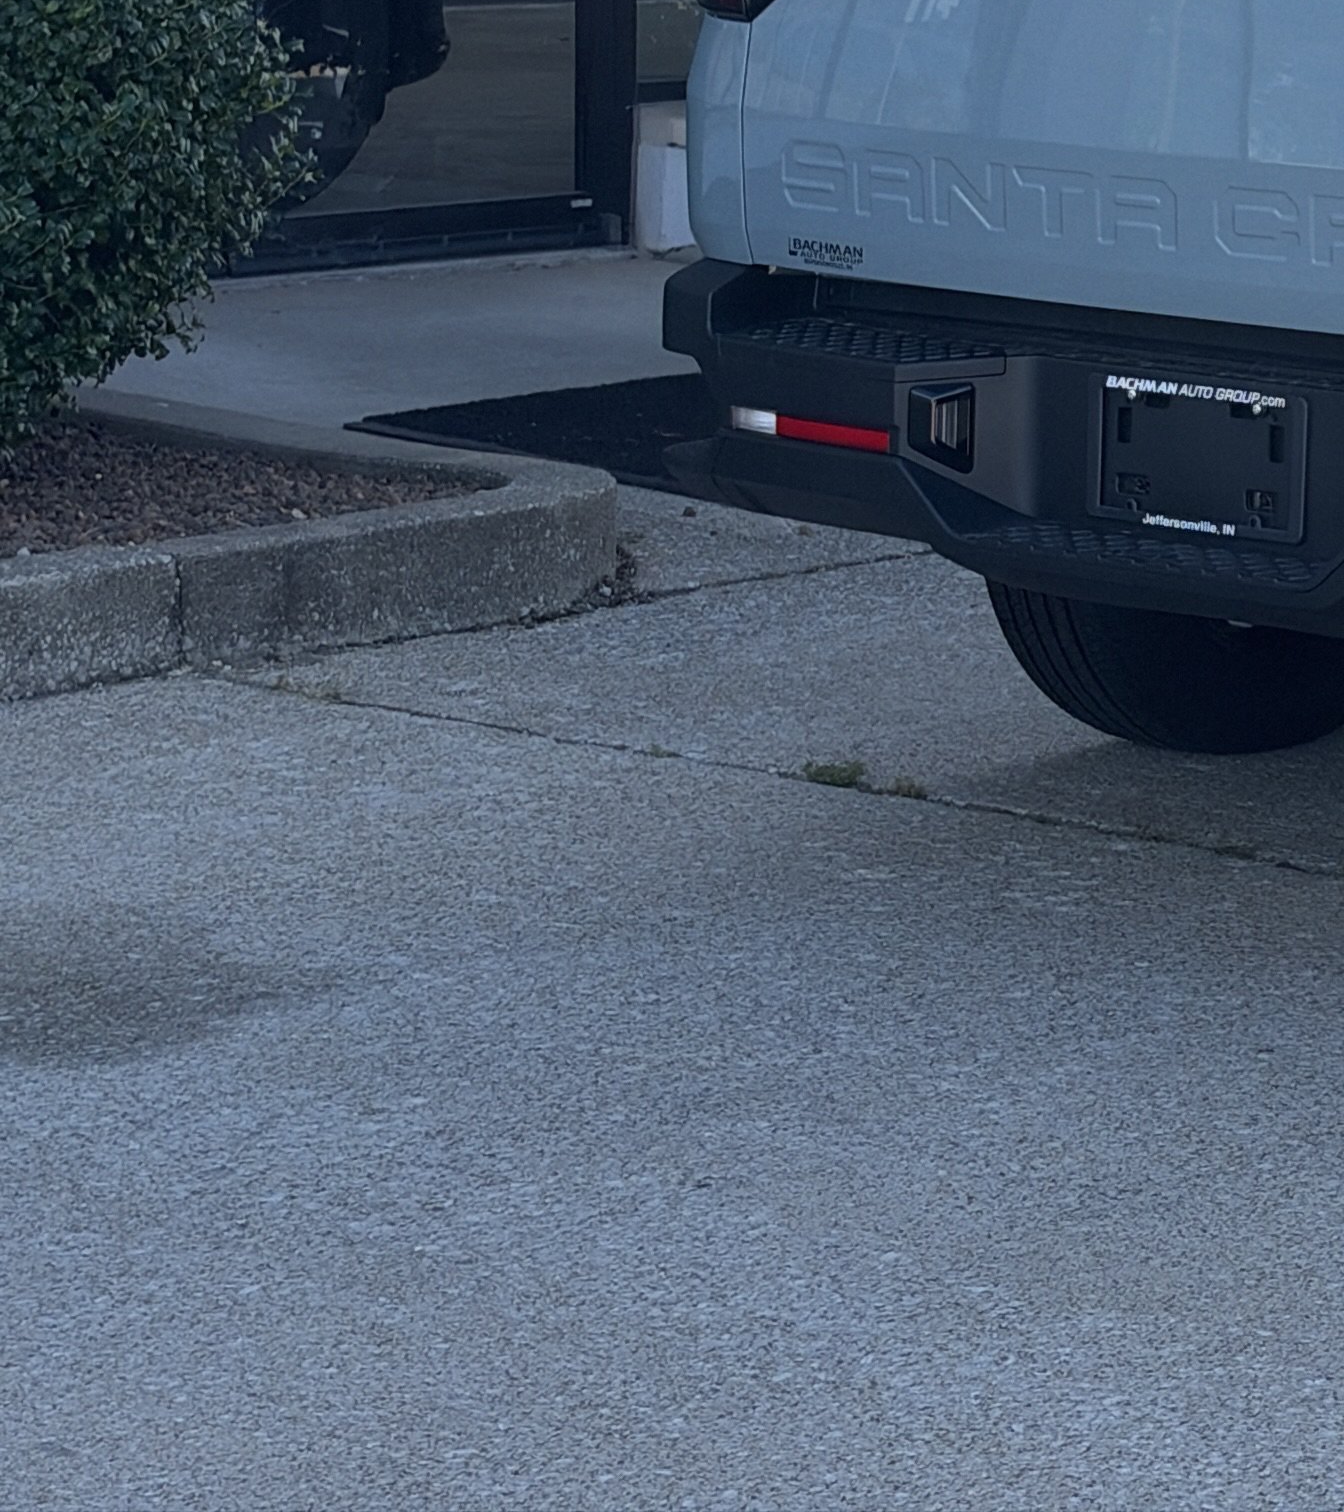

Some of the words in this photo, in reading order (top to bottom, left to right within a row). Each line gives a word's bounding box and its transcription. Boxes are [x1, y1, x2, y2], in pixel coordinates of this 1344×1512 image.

[780, 138, 1179, 252] SANTA
[792, 237, 864, 258] BACHMAN
[800, 250, 826, 261] AUTO
[1105, 375, 1179, 395] BACHMAN
[1178, 384, 1214, 400] AUTO
[1214, 388, 1287, 409] GROUP.com
[1142, 512, 1220, 536] Jeffersonville,
[1221, 524, 1236, 537] IN
